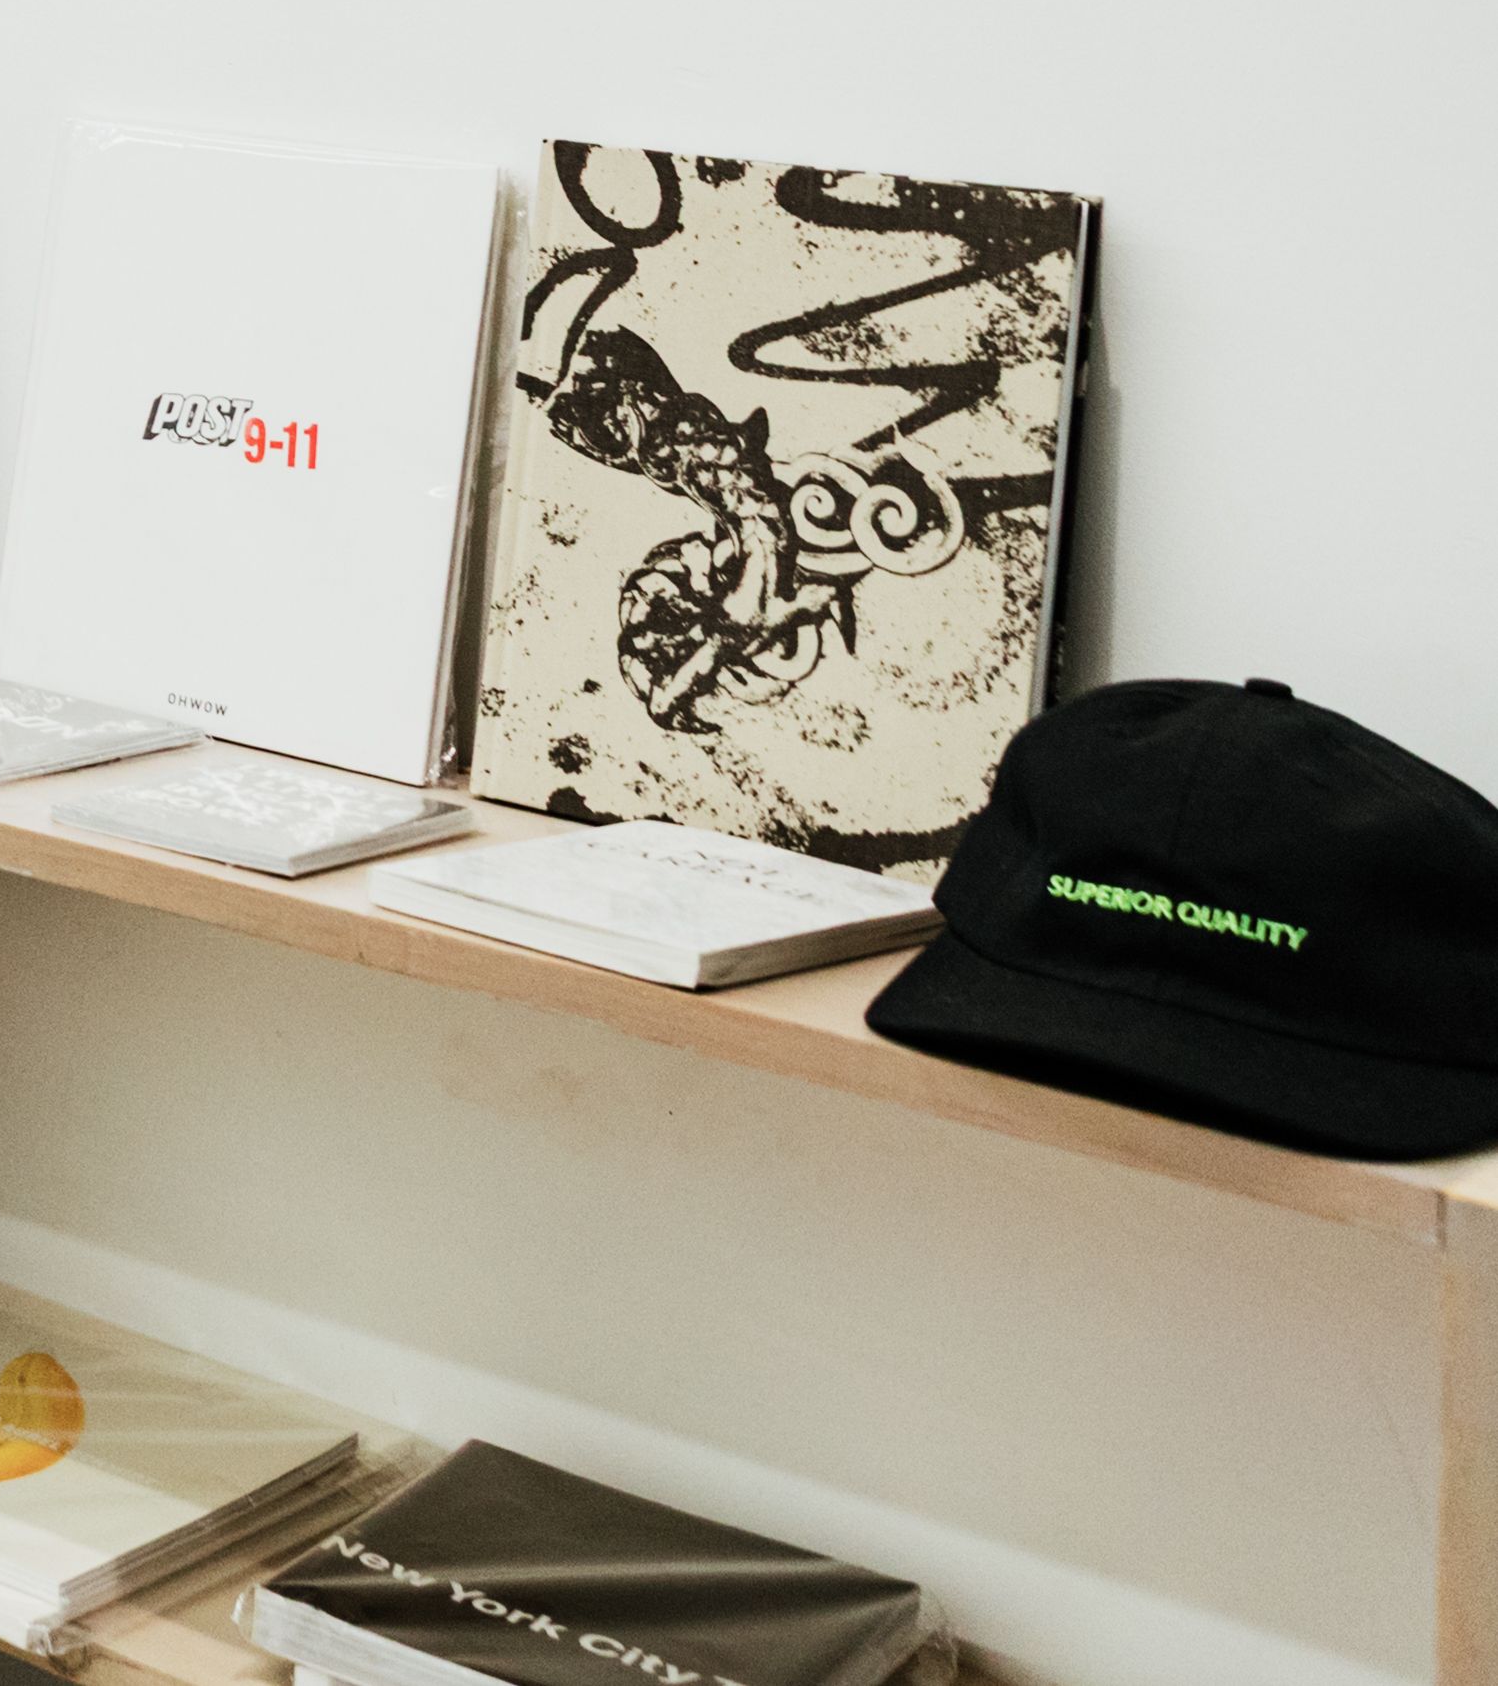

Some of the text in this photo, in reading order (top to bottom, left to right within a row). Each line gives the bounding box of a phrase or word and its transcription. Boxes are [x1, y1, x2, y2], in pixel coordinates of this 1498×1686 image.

[142, 392, 318, 470] POST 9-11
[166, 691, 229, 717] OHWOW
[1047, 874, 1308, 952] SUPERIOR QUALITY
[321, 1535, 702, 1686] New York City
